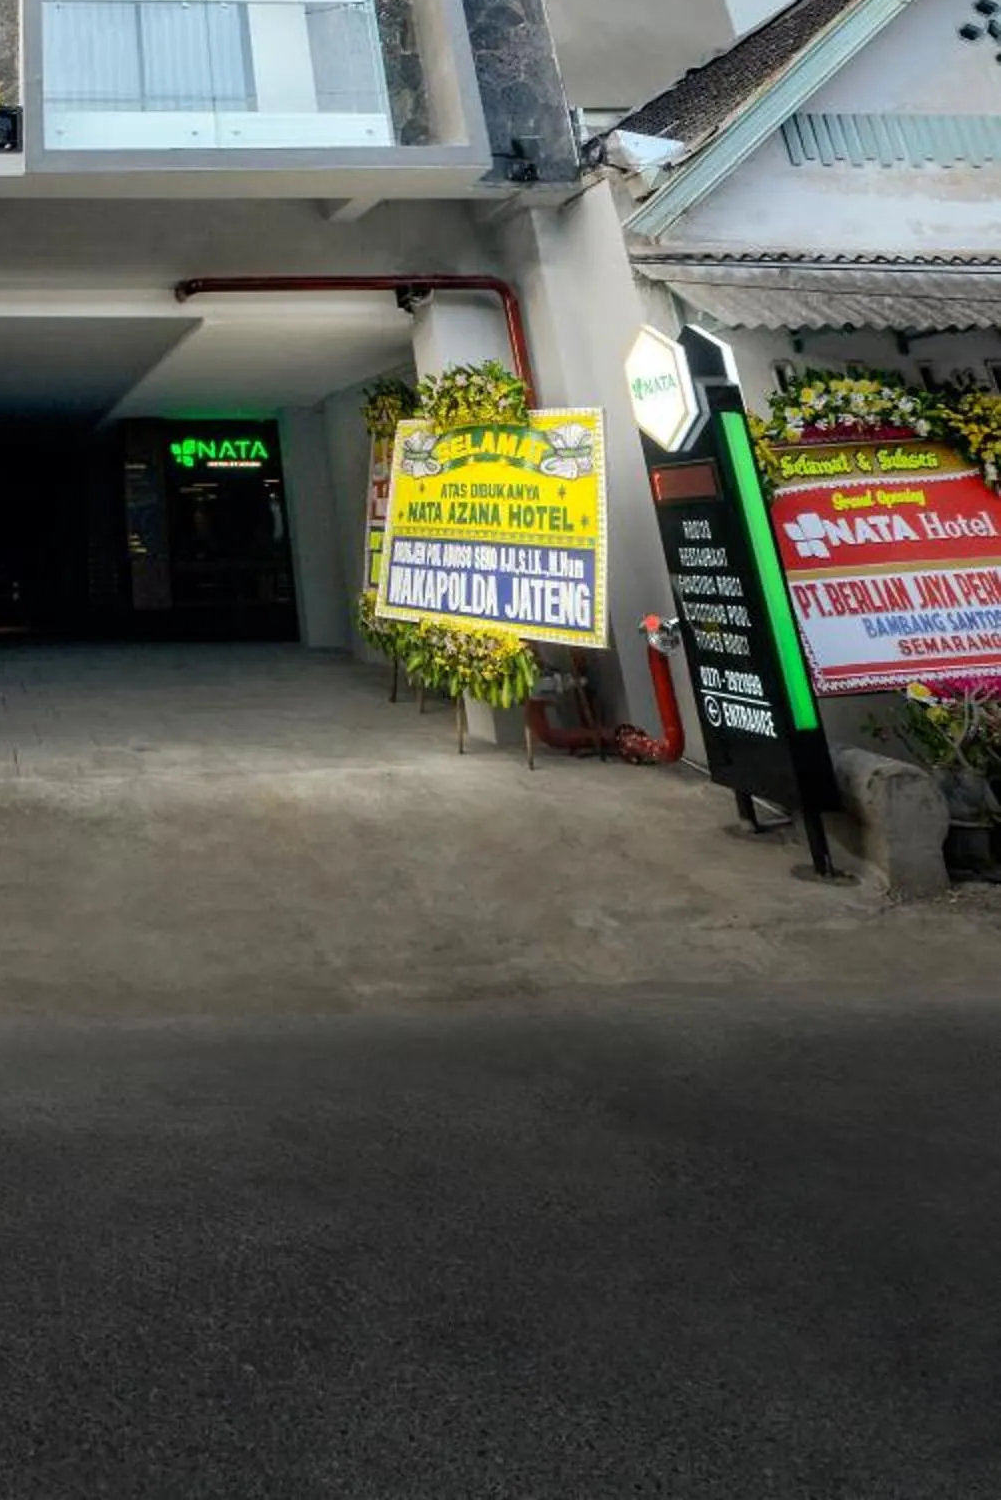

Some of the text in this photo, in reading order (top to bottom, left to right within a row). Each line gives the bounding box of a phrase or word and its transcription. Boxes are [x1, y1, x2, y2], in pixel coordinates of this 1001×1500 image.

[644, 373, 678, 397] NATA
[196, 438, 269, 460] NATA
[431, 430, 551, 465] SELAMAT
[780, 454, 851, 479] Selamat
[857, 451, 873, 471] &
[440, 483, 540, 501] ATAS DIBUKANYA
[407, 502, 442, 523] NATA
[448, 503, 501, 526] AZANA
[508, 505, 575, 532] HOTEL
[823, 510, 998, 546] NATA Hotel
[388, 565, 592, 629] WAKAPOLDA JATENG
[913, 573, 958, 610] JAYA
[862, 613, 948, 639] BAMBANG
